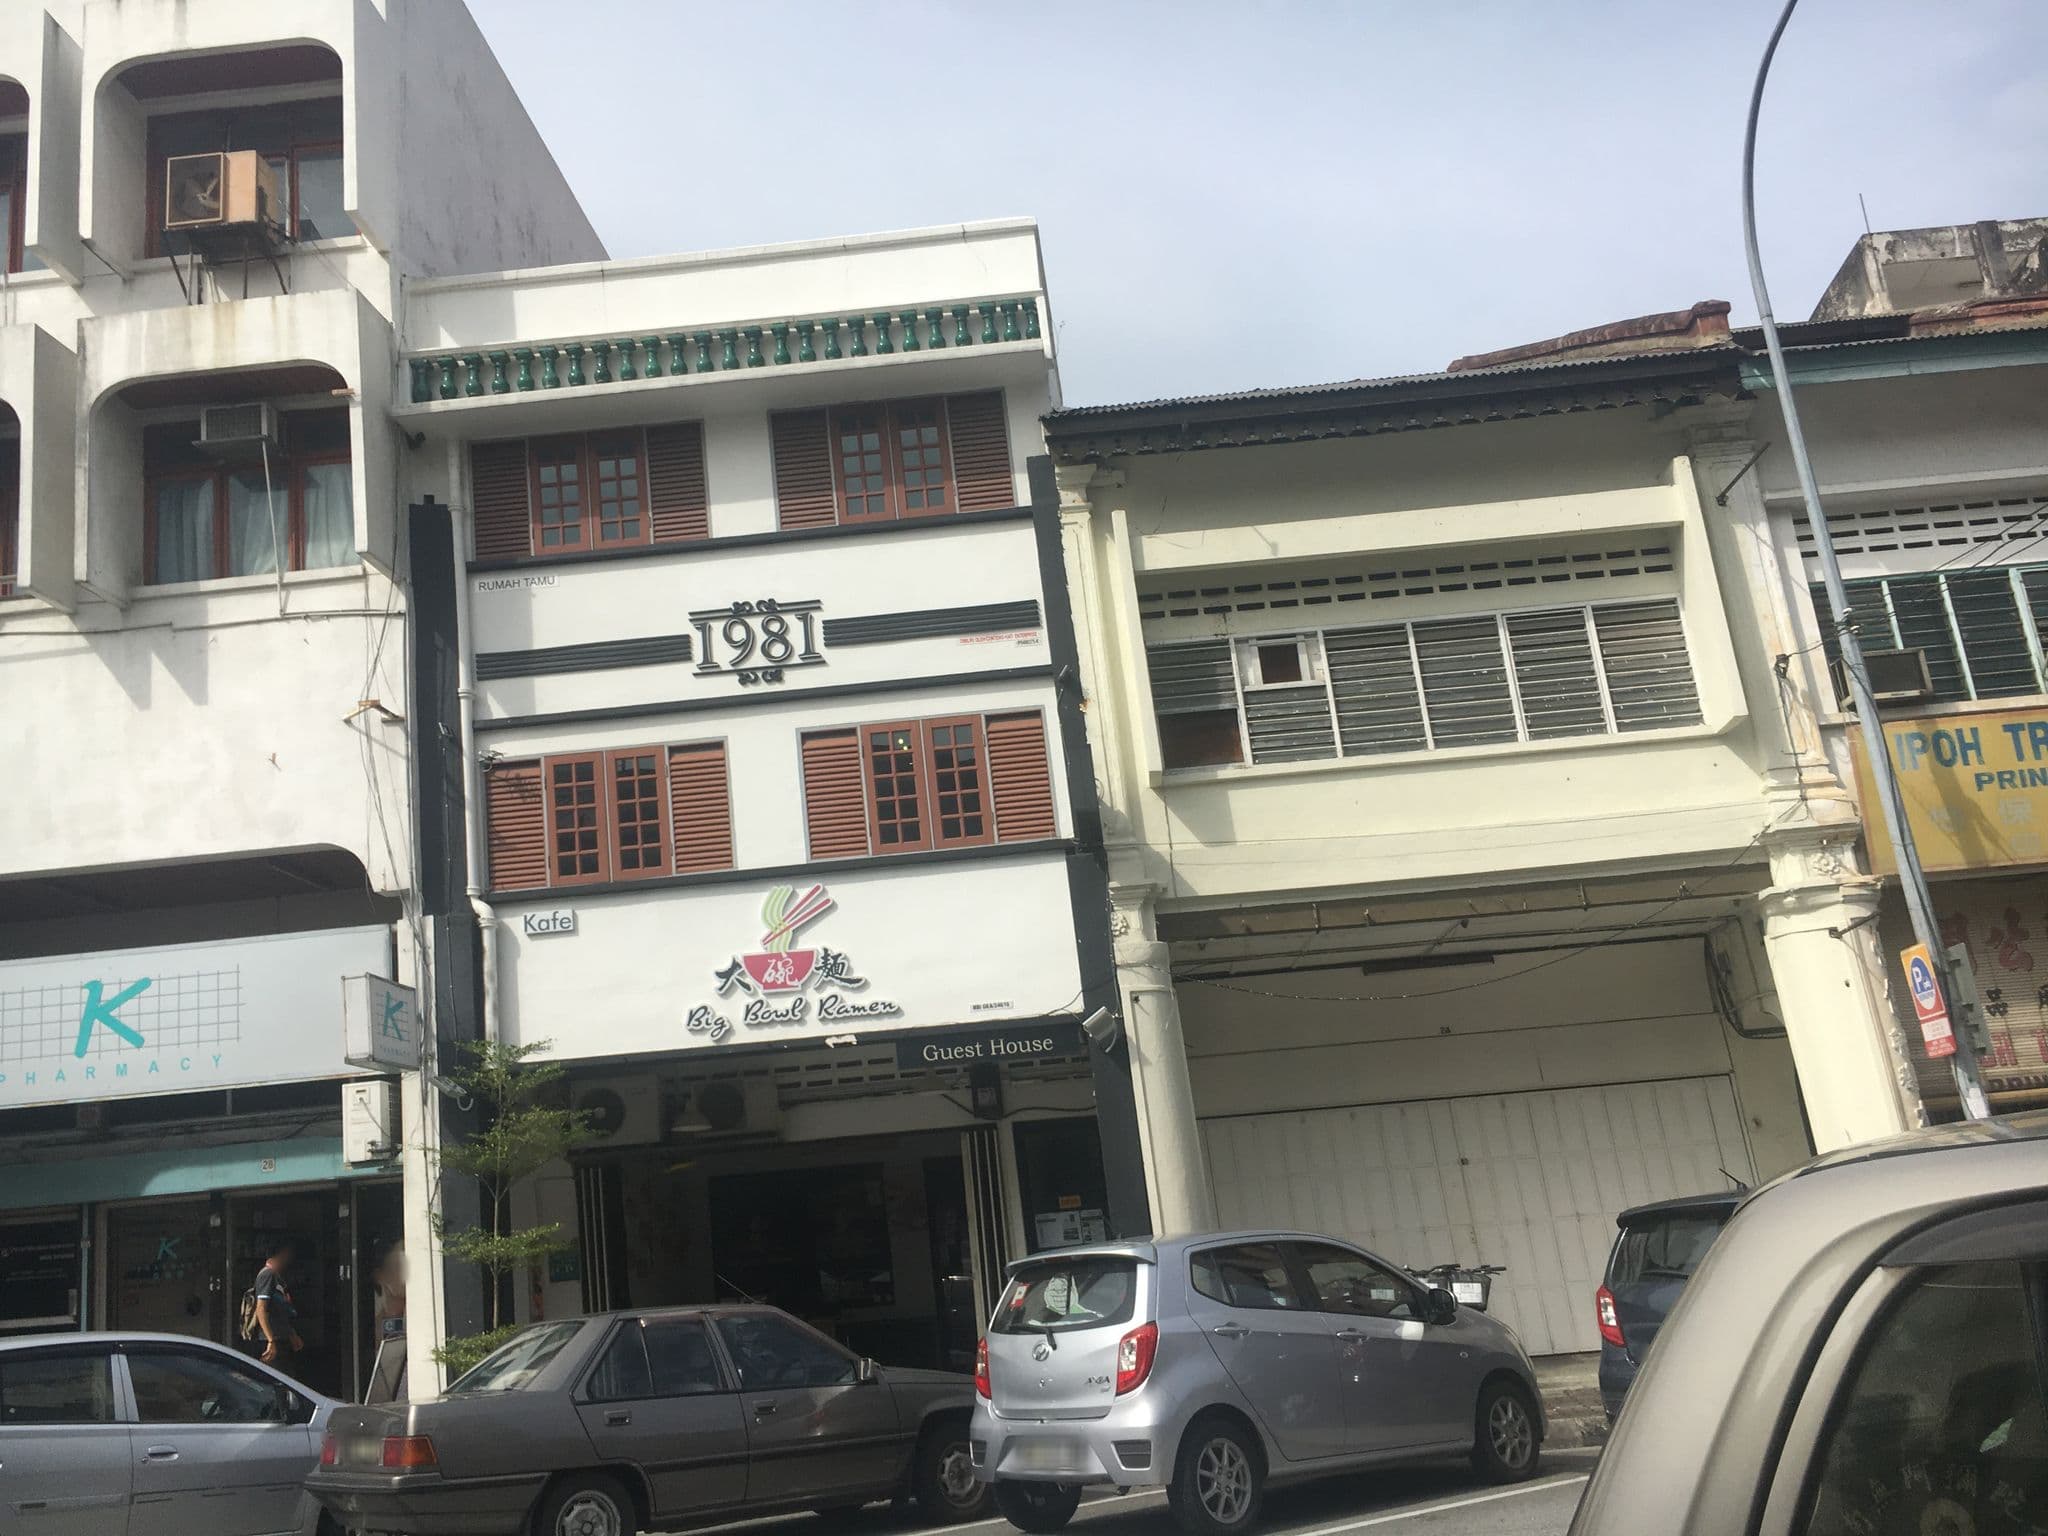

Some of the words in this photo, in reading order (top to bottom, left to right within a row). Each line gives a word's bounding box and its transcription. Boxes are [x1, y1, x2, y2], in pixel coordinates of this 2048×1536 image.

[478, 579, 521, 591] RUMAH
[523, 575, 555, 587] TAMU
[693, 611, 822, 671] 1981
[1893, 726, 1985, 771] IPOH
[1974, 767, 2048, 792] PRIN
[523, 910, 572, 933] Kafe
[74, 976, 153, 1059] K
[383, 991, 405, 1041] K
[686, 1005, 728, 1039] Big
[744, 997, 804, 1023] Bowl
[818, 994, 897, 1018] Ramen
[922, 1041, 983, 1062] Guest
[990, 1037, 1054, 1056] House
